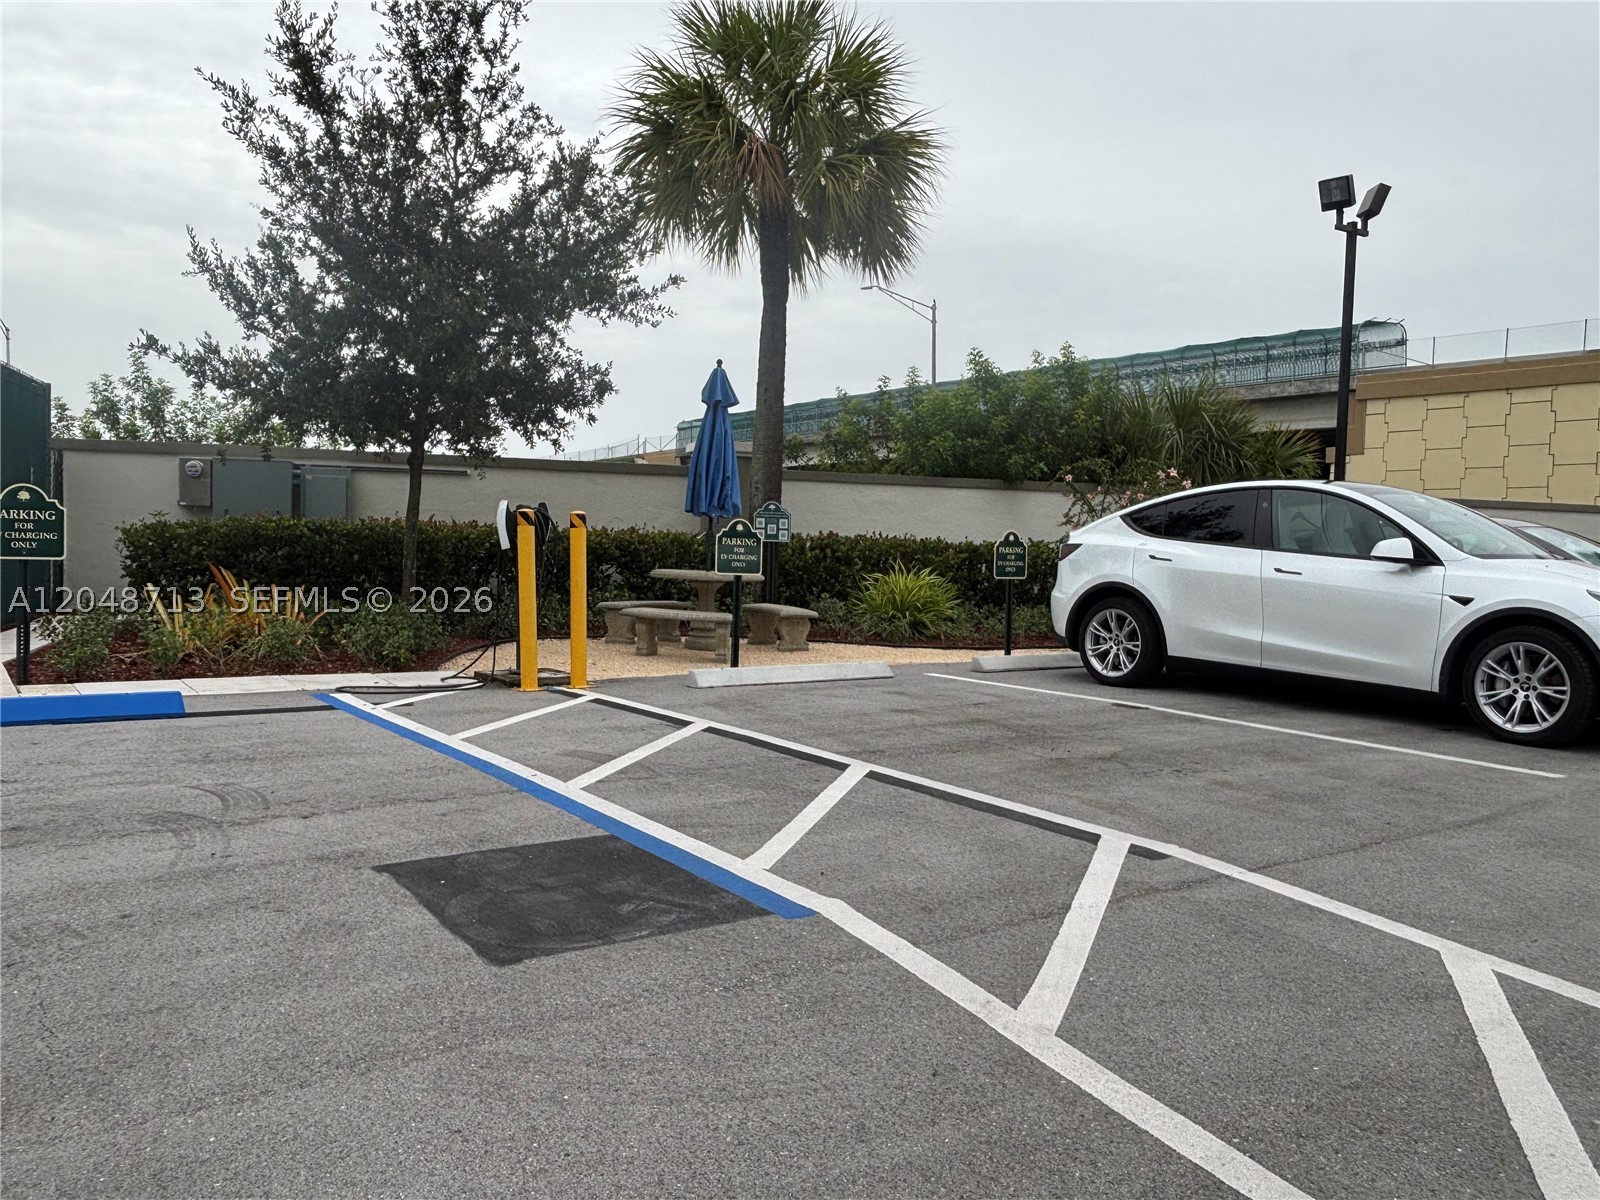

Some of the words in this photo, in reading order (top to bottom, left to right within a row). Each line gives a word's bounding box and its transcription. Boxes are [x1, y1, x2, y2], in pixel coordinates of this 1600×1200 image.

[0, 509, 56, 520] ARKING
[4, 531, 58, 539] CHARGING
[10, 541, 38, 549] ONLY
[722, 537, 757, 546] PARKING
